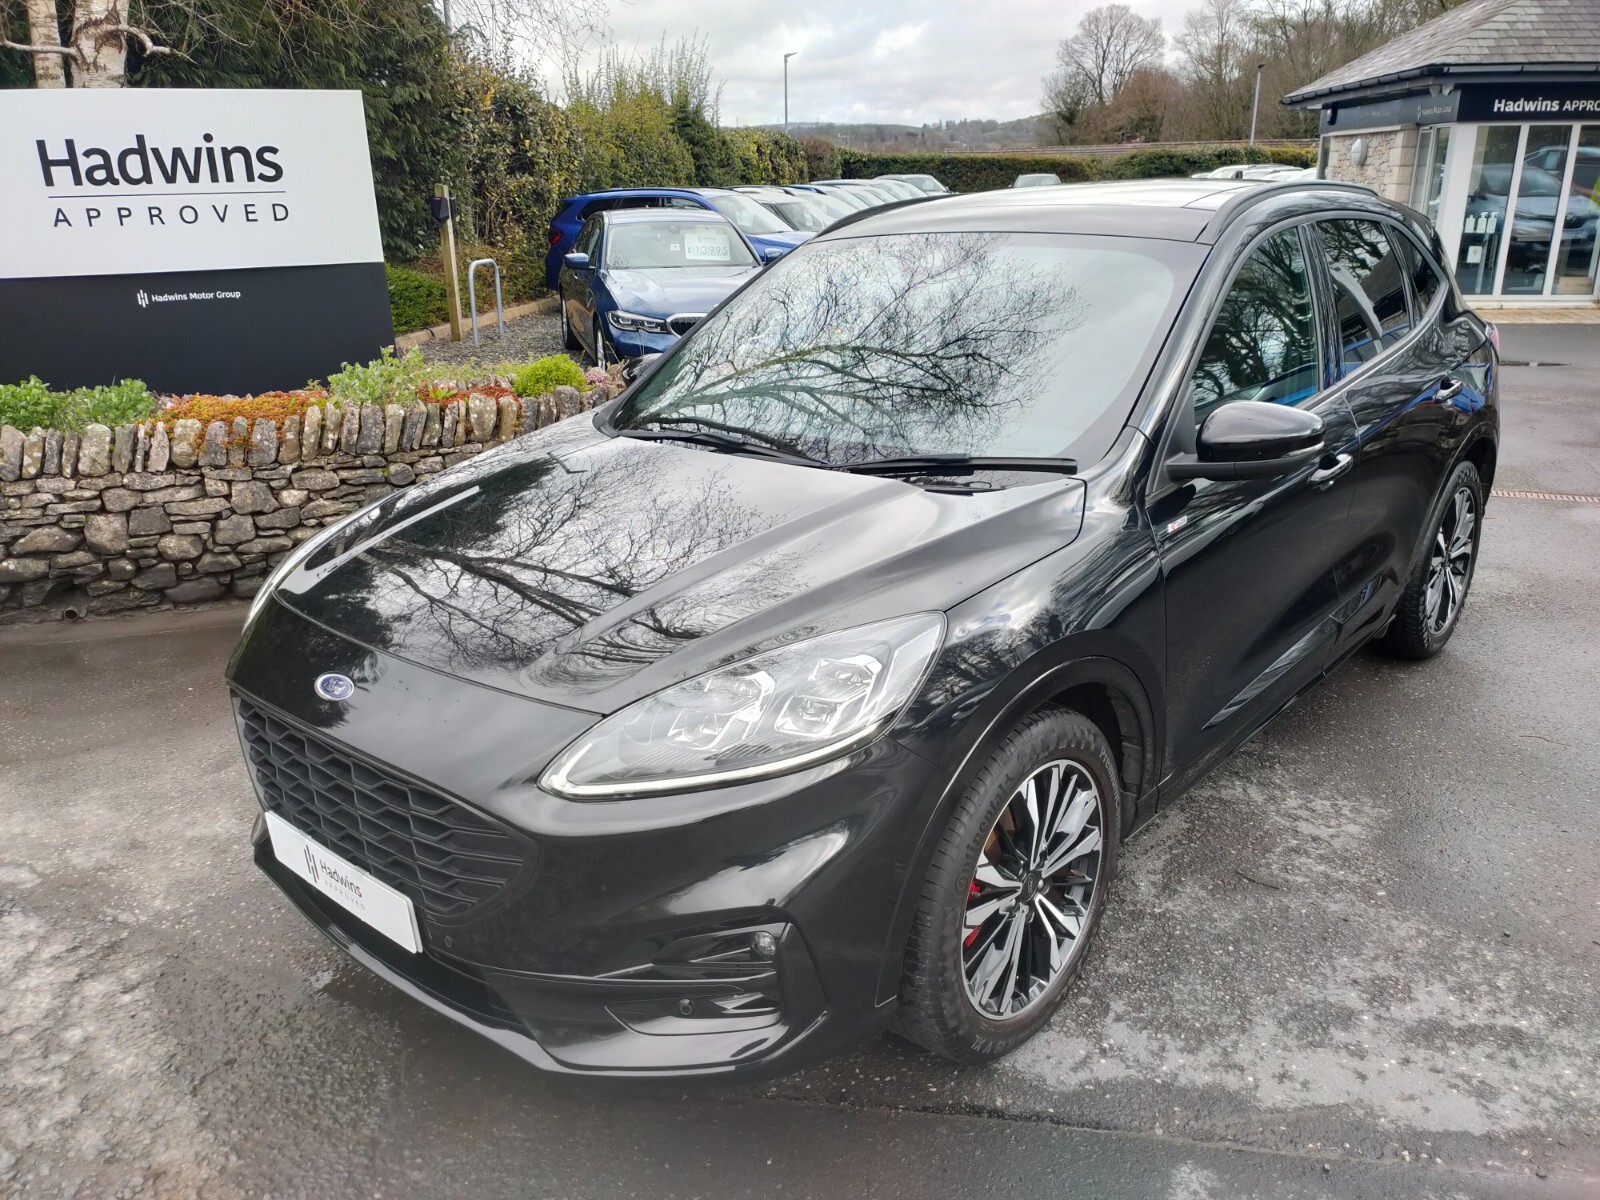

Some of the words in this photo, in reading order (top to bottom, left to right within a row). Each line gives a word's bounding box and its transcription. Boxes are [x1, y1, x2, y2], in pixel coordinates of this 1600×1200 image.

[1493, 97, 1560, 112] Hadwins
[36, 133, 284, 187] Hadwins
[53, 203, 290, 227] APPROVED
[151, 293, 188, 302] Hadwins
[189, 292, 214, 300] Motor
[216, 291, 241, 299] Group
[319, 859, 362, 898] Hadwins
